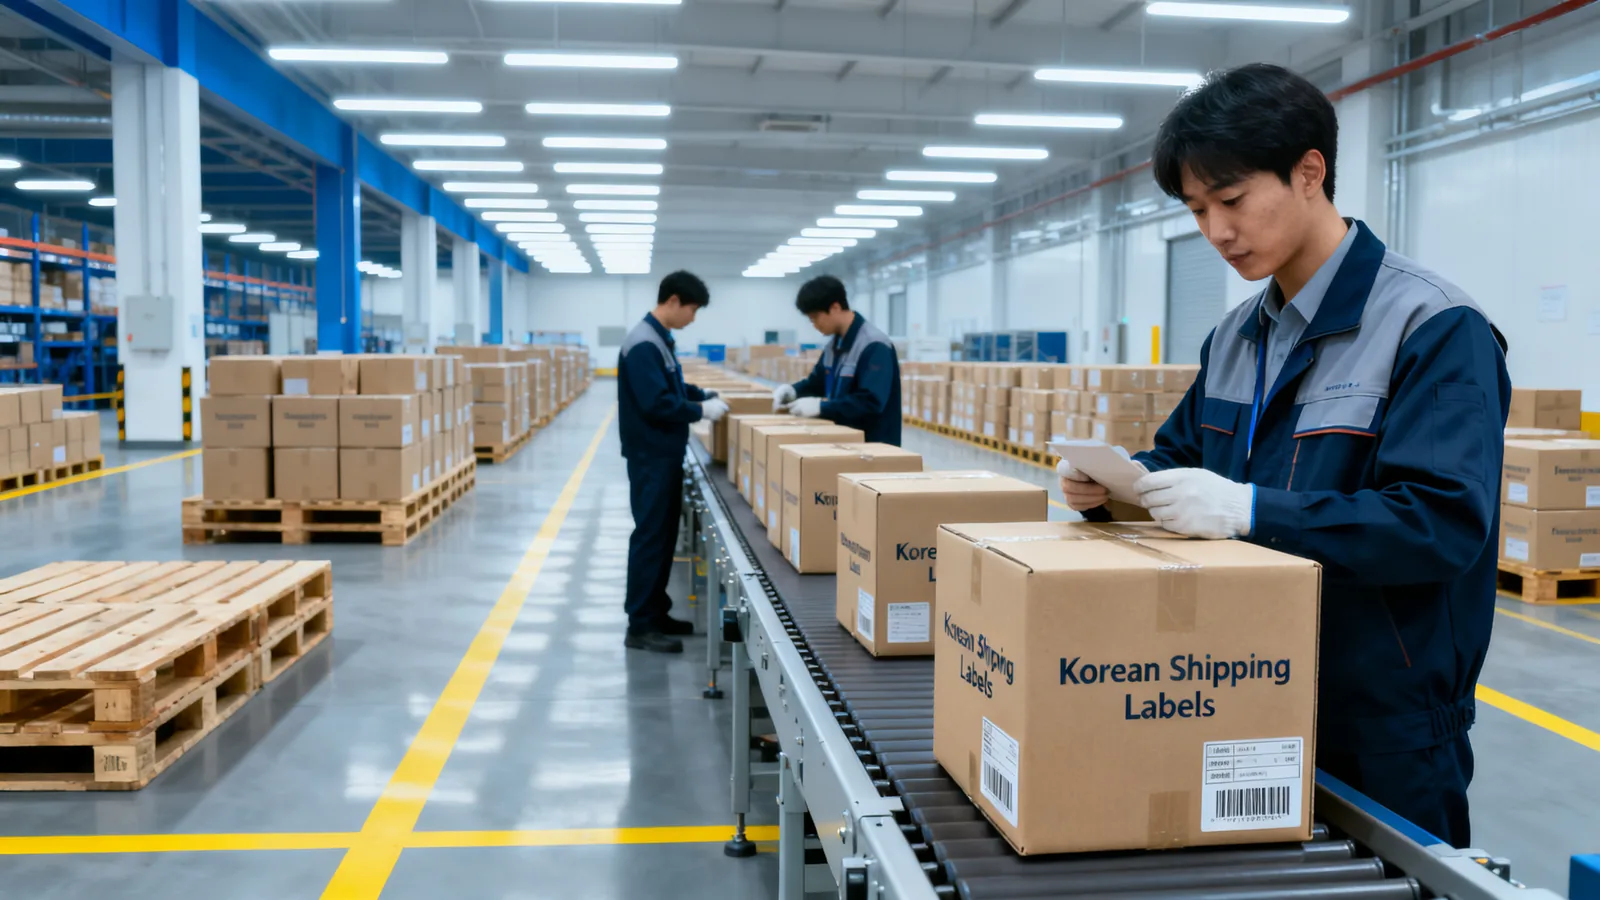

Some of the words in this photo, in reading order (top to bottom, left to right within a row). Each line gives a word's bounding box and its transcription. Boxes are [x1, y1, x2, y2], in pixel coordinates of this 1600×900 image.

[896, 542, 937, 561] Kore
[1059, 656, 1160, 685] Korean
[1169, 653, 1290, 688] Shipping
[1125, 691, 1216, 720] Labels
